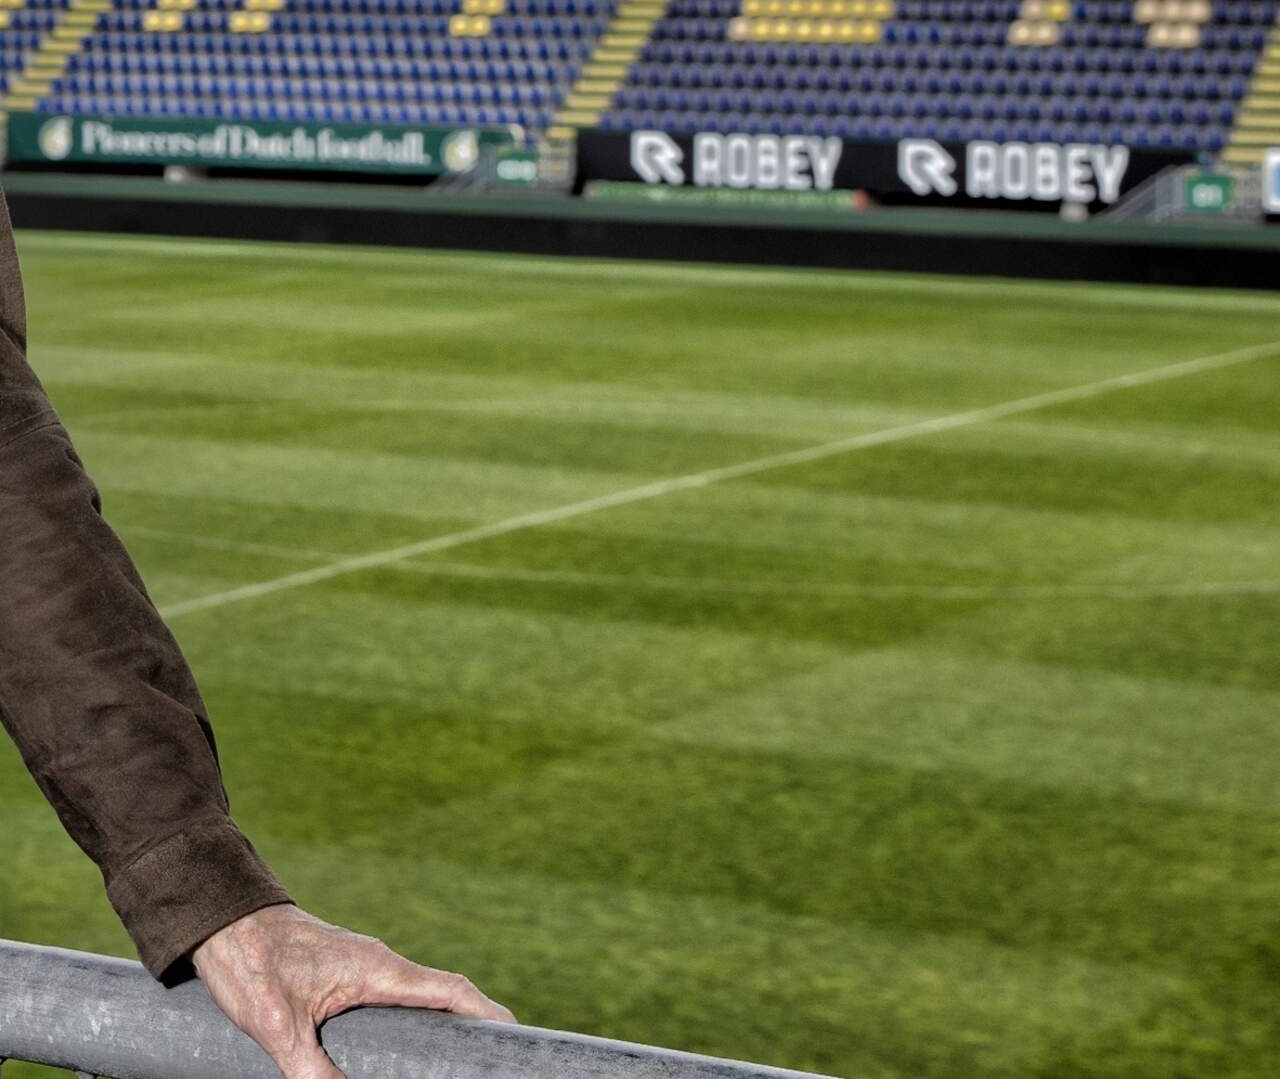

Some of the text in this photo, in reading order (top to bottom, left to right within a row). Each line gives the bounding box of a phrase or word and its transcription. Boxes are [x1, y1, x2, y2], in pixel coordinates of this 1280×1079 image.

[81, 120, 196, 156] Pioneers
[198, 125, 230, 157] of
[230, 125, 315, 160] Dutch
[693, 131, 842, 190] ROBEY
[966, 140, 1129, 203] ROBEY
